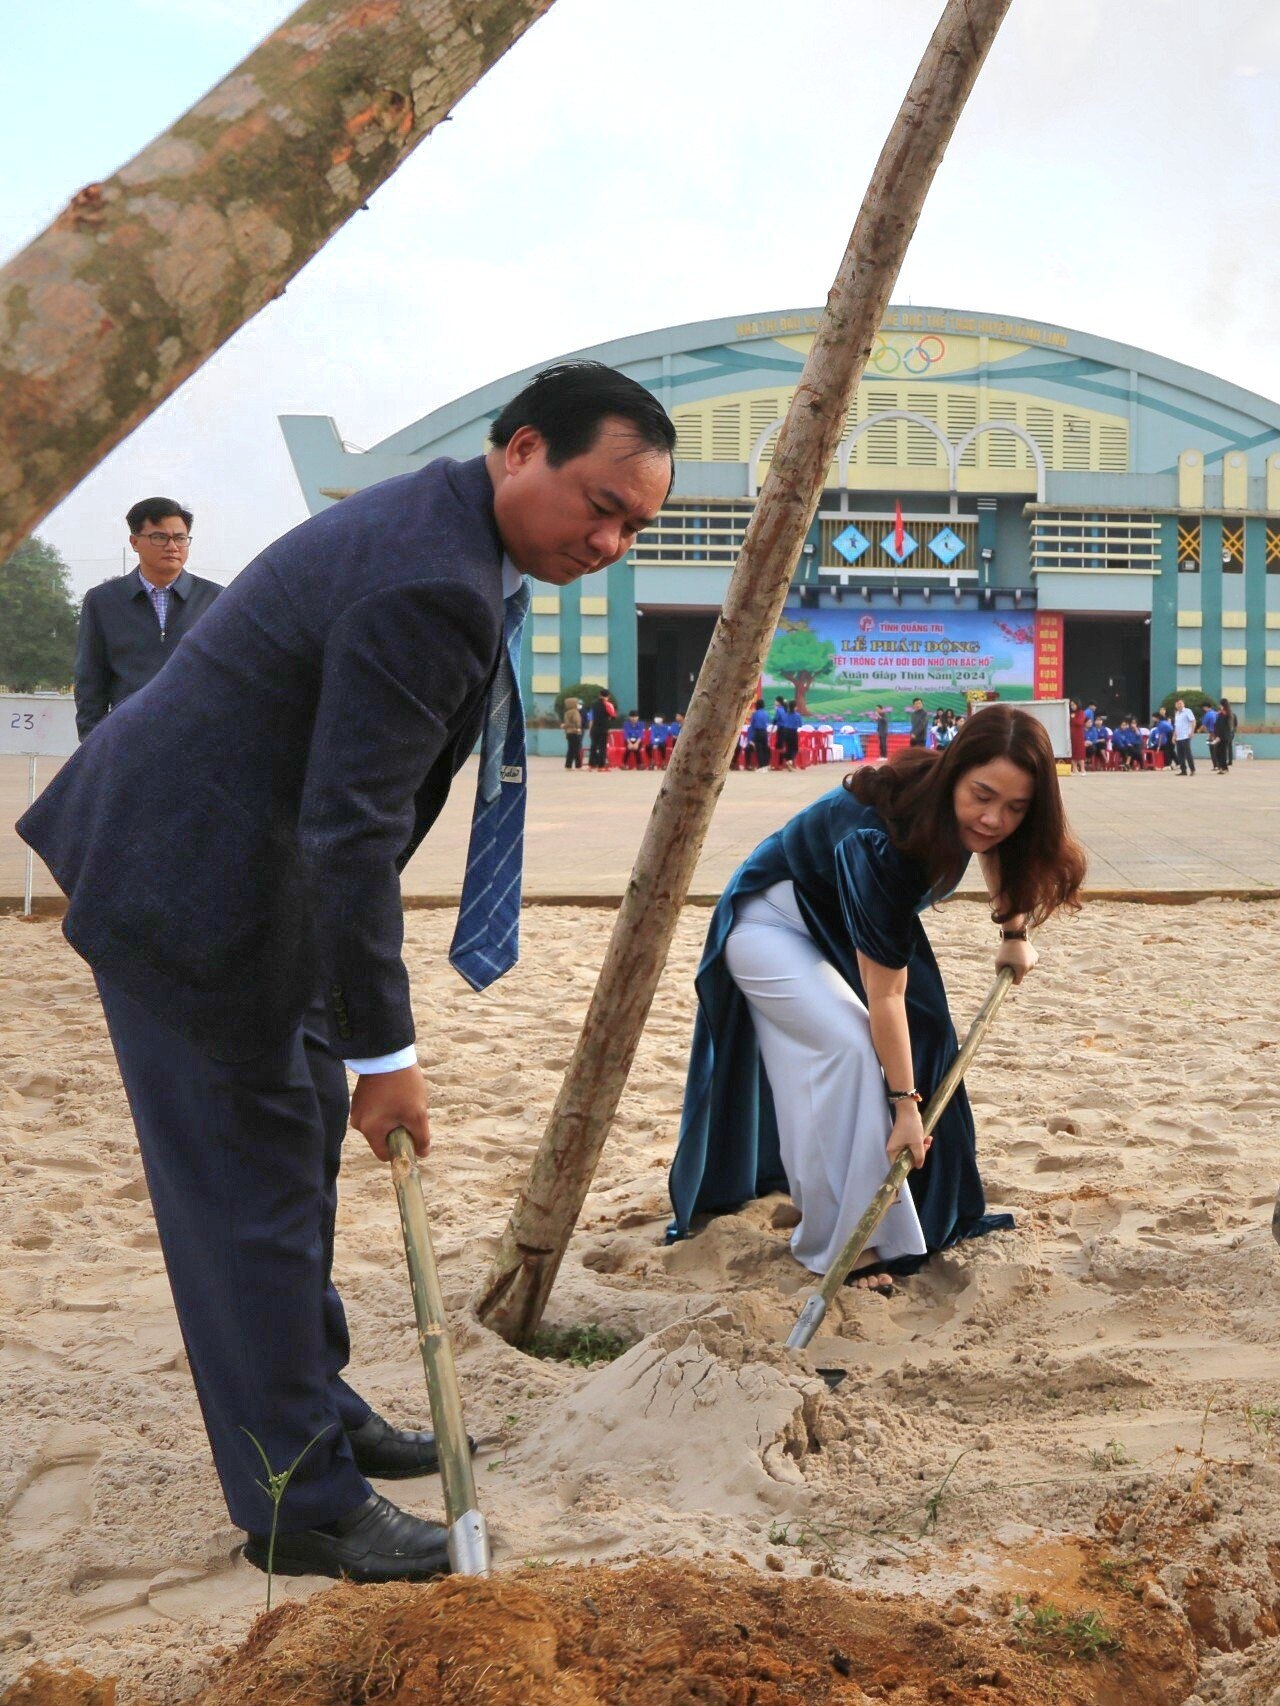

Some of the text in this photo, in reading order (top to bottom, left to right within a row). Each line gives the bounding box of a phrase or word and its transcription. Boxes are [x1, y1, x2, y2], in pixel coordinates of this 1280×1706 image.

[841, 635, 980, 655] LỄ PHÁT ĐỘNG
[842, 670, 868, 679] Xuân
[872, 670, 896, 680] Giáp
[927, 671, 952, 680] Năm
[956, 671, 985, 680] 2024
[11, 713, 34, 730] 23
